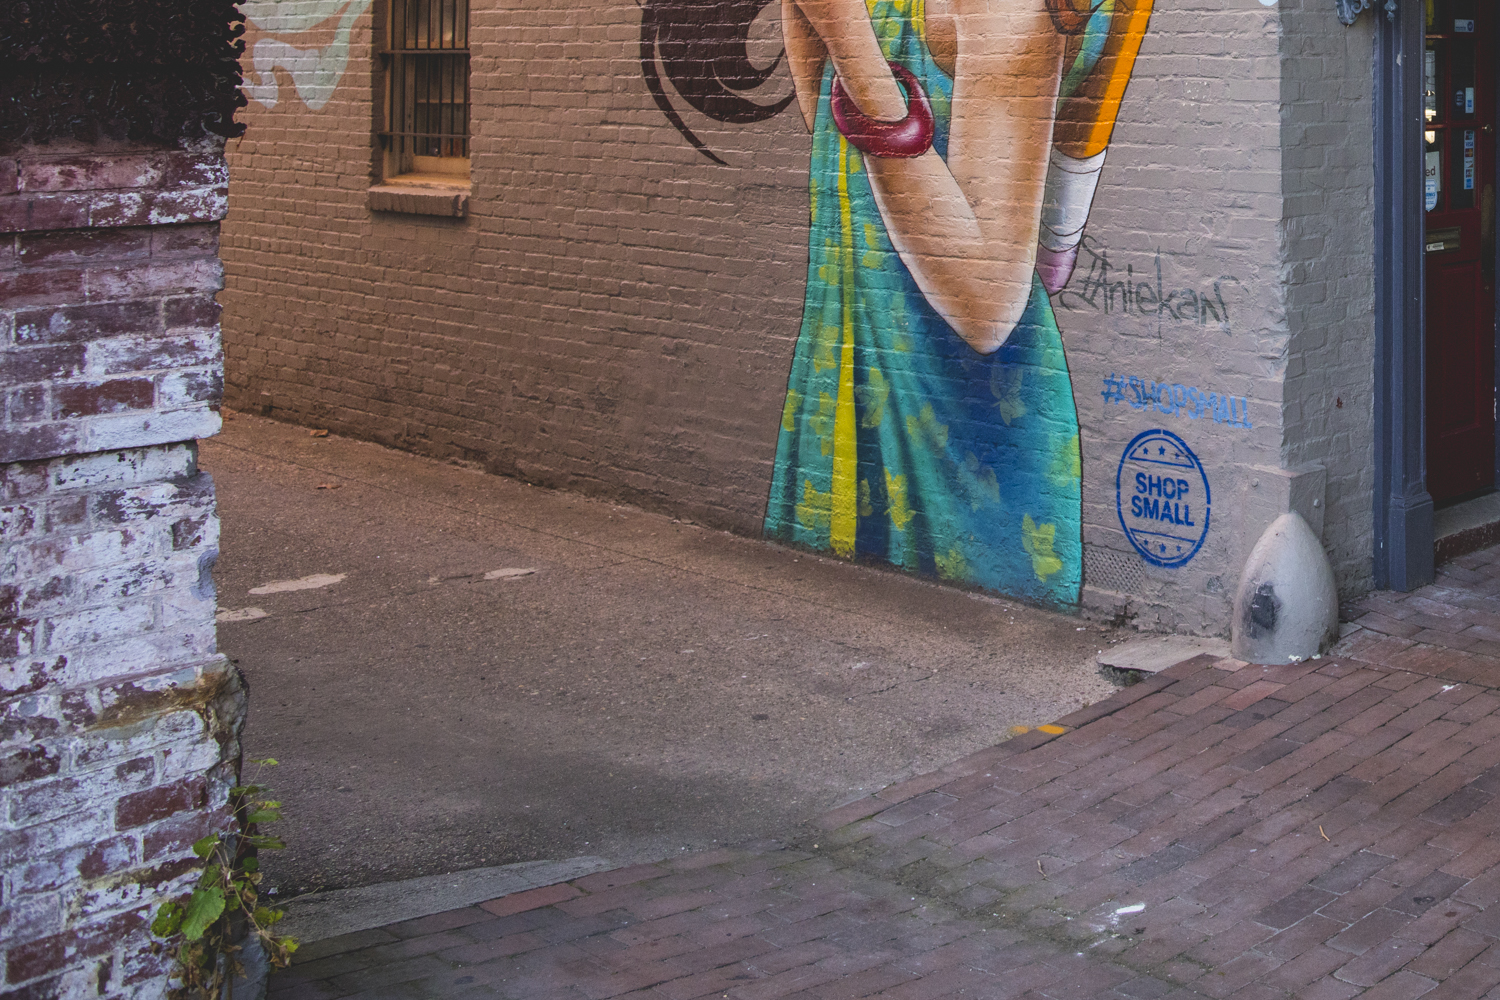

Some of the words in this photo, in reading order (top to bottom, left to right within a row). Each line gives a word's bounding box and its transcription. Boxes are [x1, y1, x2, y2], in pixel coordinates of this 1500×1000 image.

[1100, 372, 1253, 429] #SHOPSMALL
[1134, 472, 1190, 501] SHOP
[1130, 495, 1195, 527] SMALL
